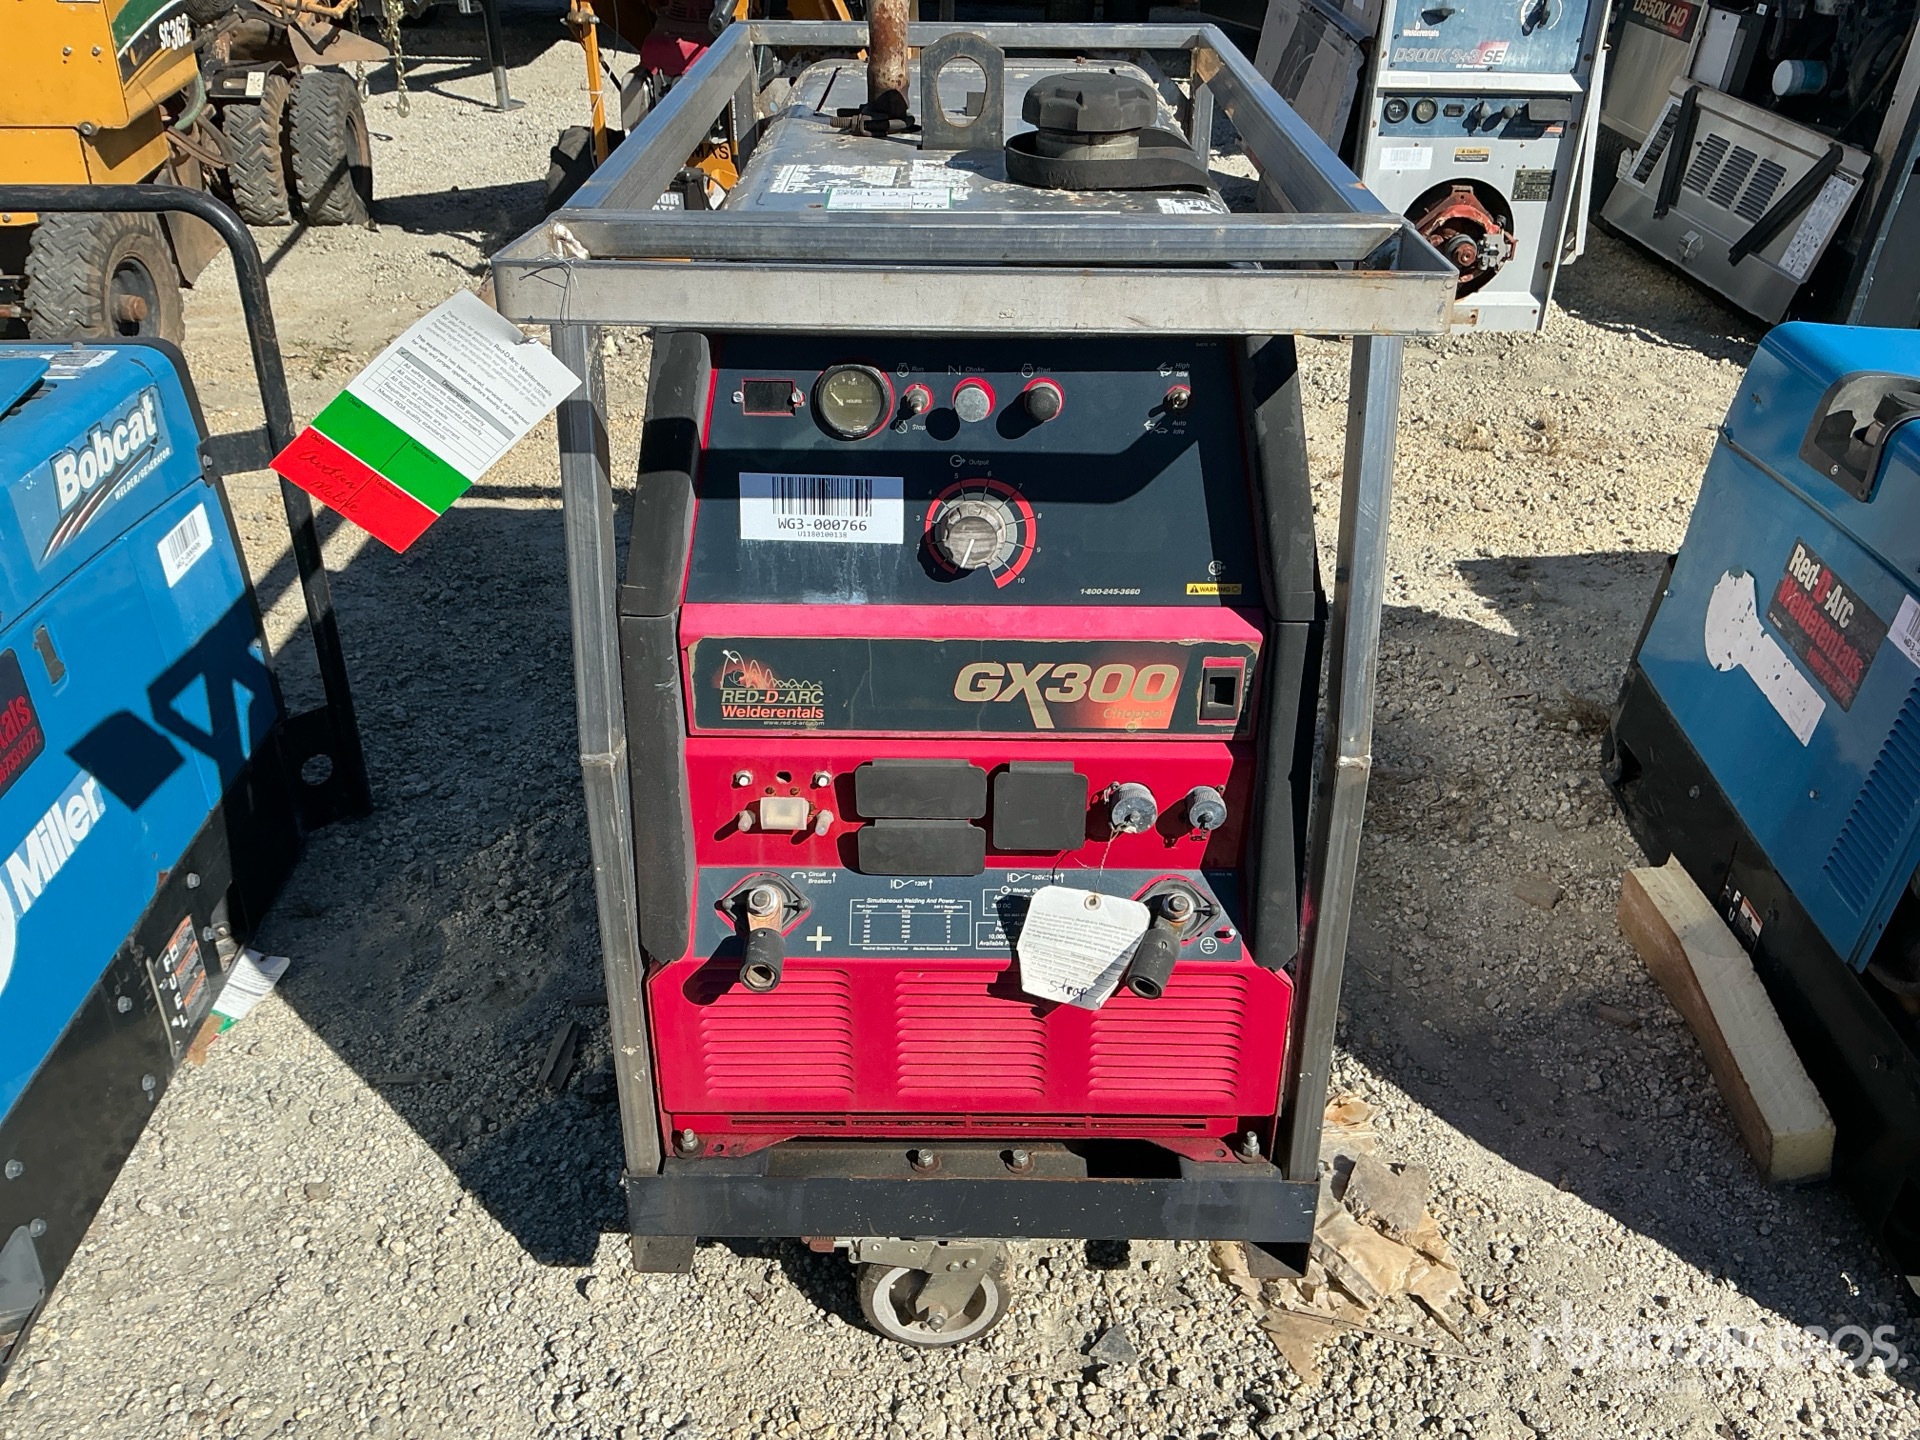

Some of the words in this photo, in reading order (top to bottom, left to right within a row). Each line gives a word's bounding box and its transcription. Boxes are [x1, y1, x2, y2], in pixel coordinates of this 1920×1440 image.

[159, 13, 191, 50] SC362
[1393, 48, 1451, 63] D300K
[1450, 49, 1480, 63] 3+3
[1483, 50, 1504, 63] SE
[441, 379, 471, 405] Description
[493, 343, 520, 366] Red-D-Arc
[518, 365, 553, 396] Welderentals
[383, 381, 407, 400] Required
[405, 397, 433, 419] certificates
[432, 418, 442, 426] are
[441, 425, 460, 440] current
[389, 374, 398, 382] All
[397, 380, 412, 392] fluids
[416, 395, 434, 410] proper
[434, 407, 448, 420] levels
[396, 368, 404, 376] All
[403, 374, 422, 389] control
[421, 387, 445, 405] functions
[443, 404, 463, 420] operate
[461, 418, 483, 436] properly
[410, 367, 426, 381] safety
[425, 378, 447, 396] features
[445, 395, 465, 411] operate
[464, 409, 485, 427] properly
[54, 393, 158, 511] Bobcat
[114, 447, 171, 500] WELDER/GENERATOR
[968, 459, 989, 467] Output
[778, 518, 867, 531] WG3-000766
[1200, 585, 1231, 593] WARNING
[1788, 543, 1854, 629] Red-D-Arc
[1778, 573, 1865, 683] Welderentals
[721, 690, 824, 704] RED-D-ARC
[722, 705, 824, 719] Welderentals
[954, 662, 1180, 729] GX300
[6, 776, 100, 914] Miller
